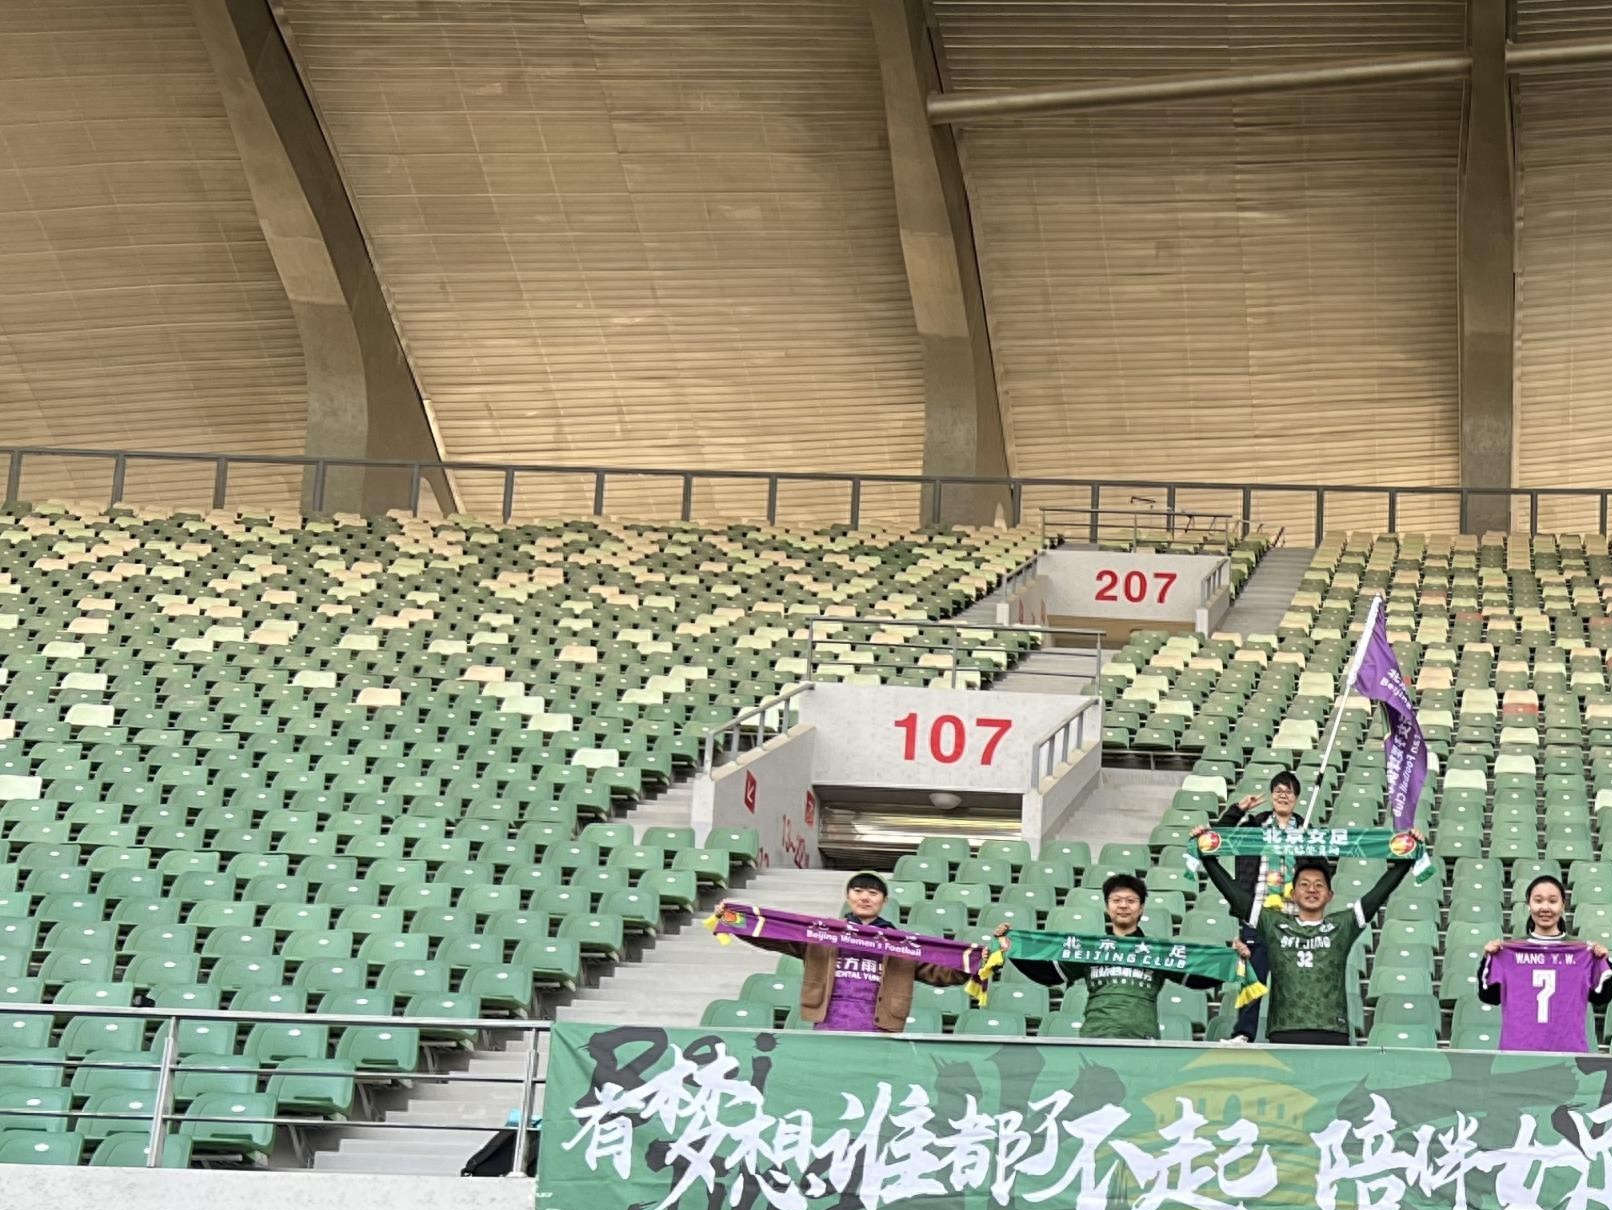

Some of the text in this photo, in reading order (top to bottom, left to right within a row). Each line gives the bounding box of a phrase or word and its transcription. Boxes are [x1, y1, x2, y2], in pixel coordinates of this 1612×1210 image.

[1095, 570, 1177, 603] 207
[894, 712, 1012, 766] 107
[806, 929, 838, 943] Beijing
[1062, 949, 1187, 969] BEIJING CLUB
[1296, 950, 1314, 968] 32
[1515, 952, 1545, 965] WANG
[1533, 969, 1556, 1023] 7
